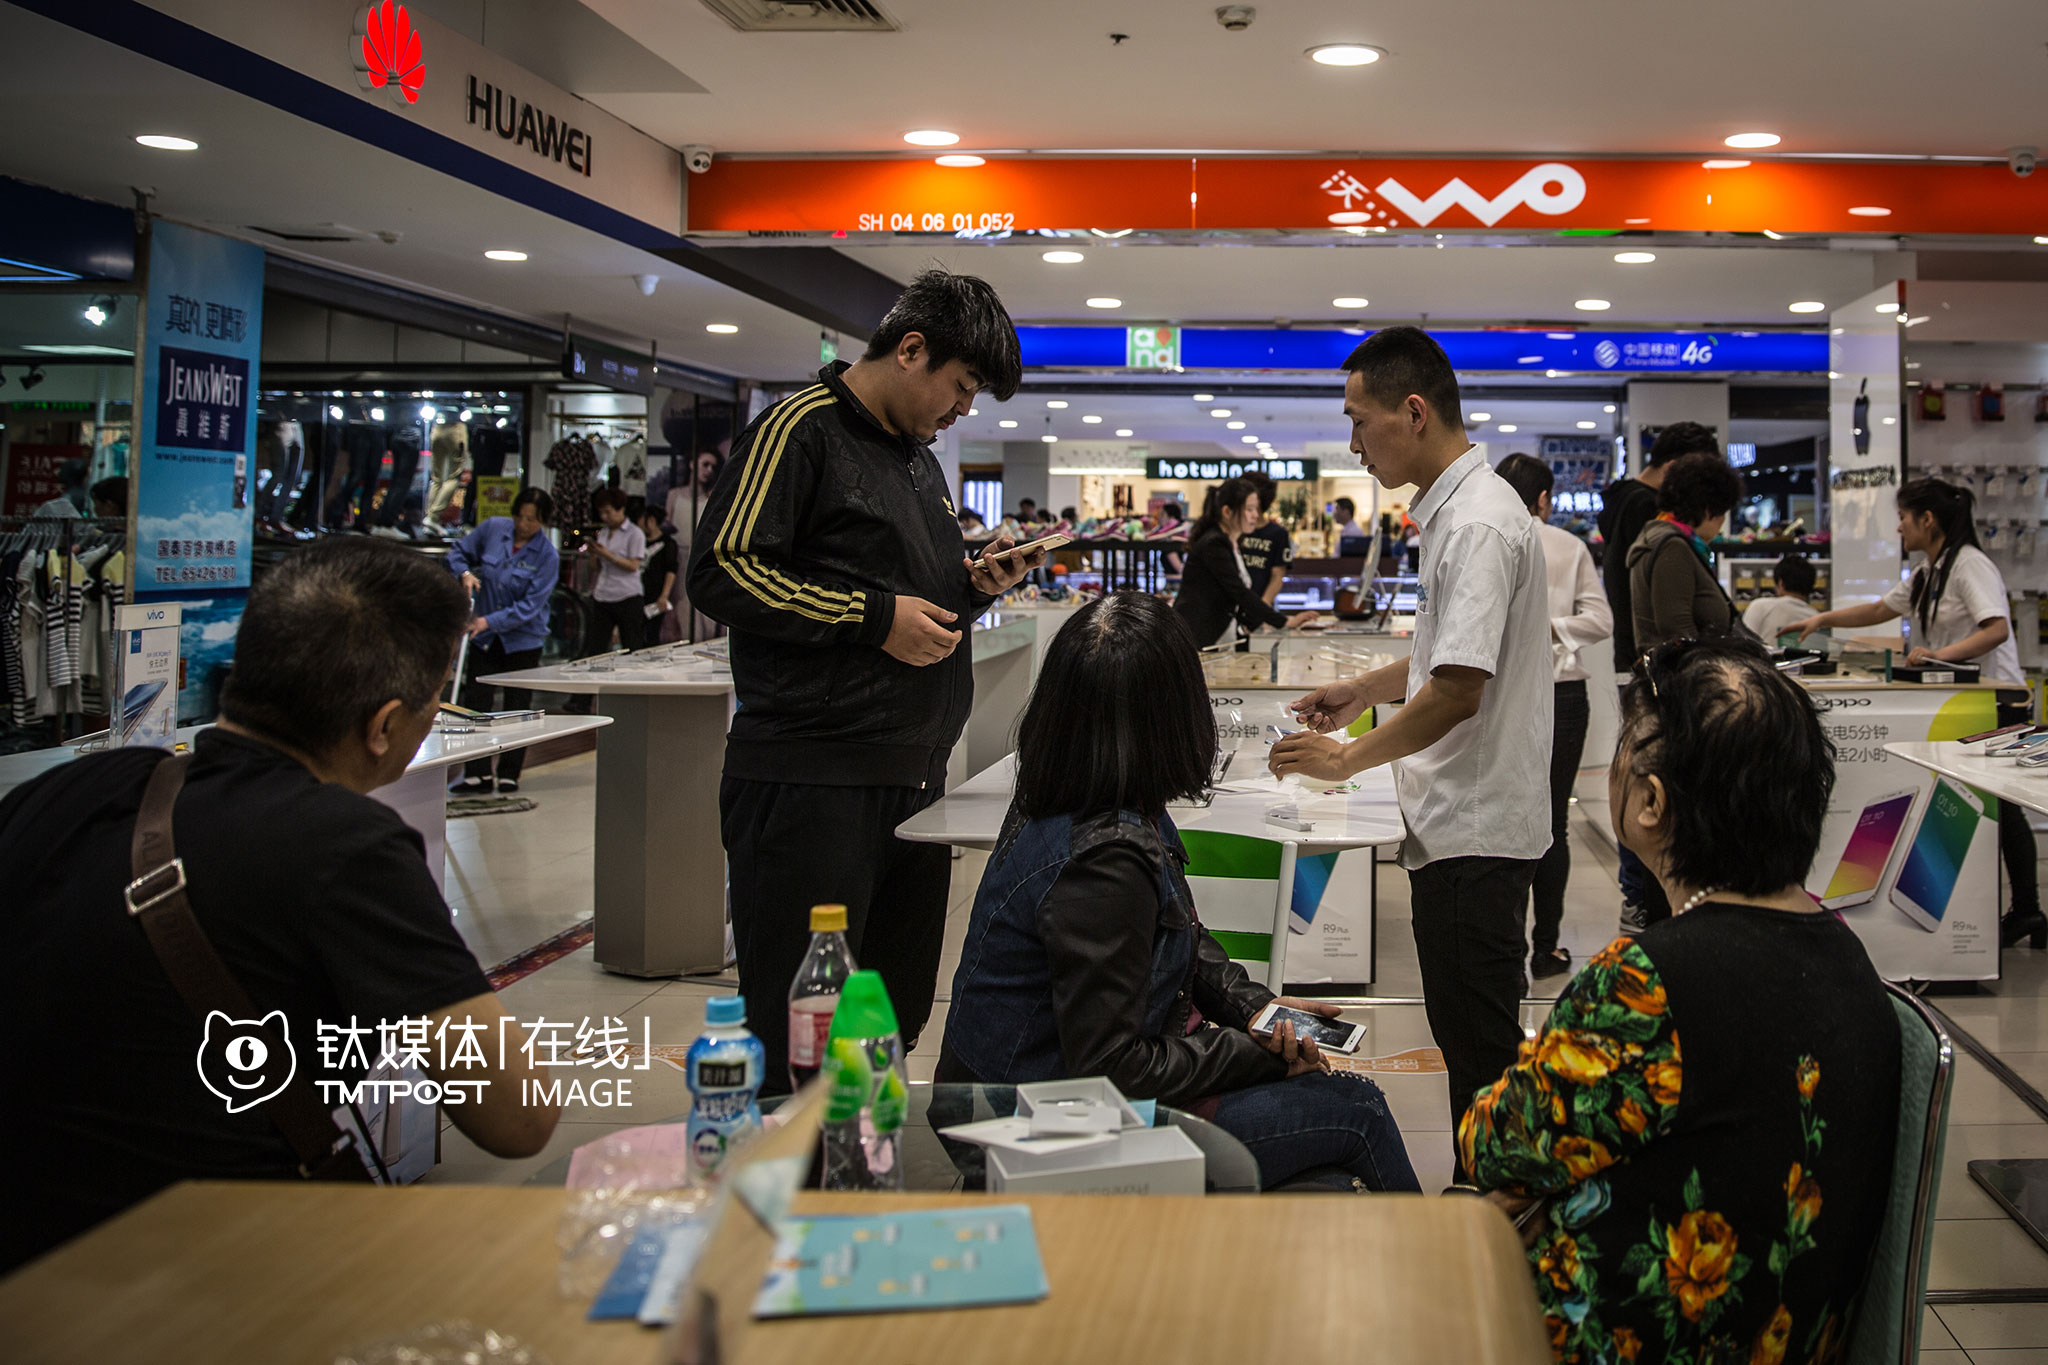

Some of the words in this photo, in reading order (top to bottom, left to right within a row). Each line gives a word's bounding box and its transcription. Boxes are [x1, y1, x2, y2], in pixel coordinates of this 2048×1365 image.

[467, 74, 592, 178] HUAWEI
[858, 213, 884, 231] SH
[890, 213, 914, 231] 04
[921, 213, 945, 231] 06
[952, 213, 972, 231] 01
[979, 213, 1015, 231] 052
[1623, 342, 1678, 357] 中国移动
[1681, 340, 1713, 365] 4G
[1158, 459, 1259, 479] hotwind
[147, 610, 165, 620] vivo
[1210, 698, 1243, 706] po
[1816, 698, 1871, 708] oppo
[1218, 724, 1259, 738] 5分钟
[1834, 747, 1888, 763] 话2小时
[1323, 923, 1337, 934] R9
[1952, 920, 1966, 931] R9
